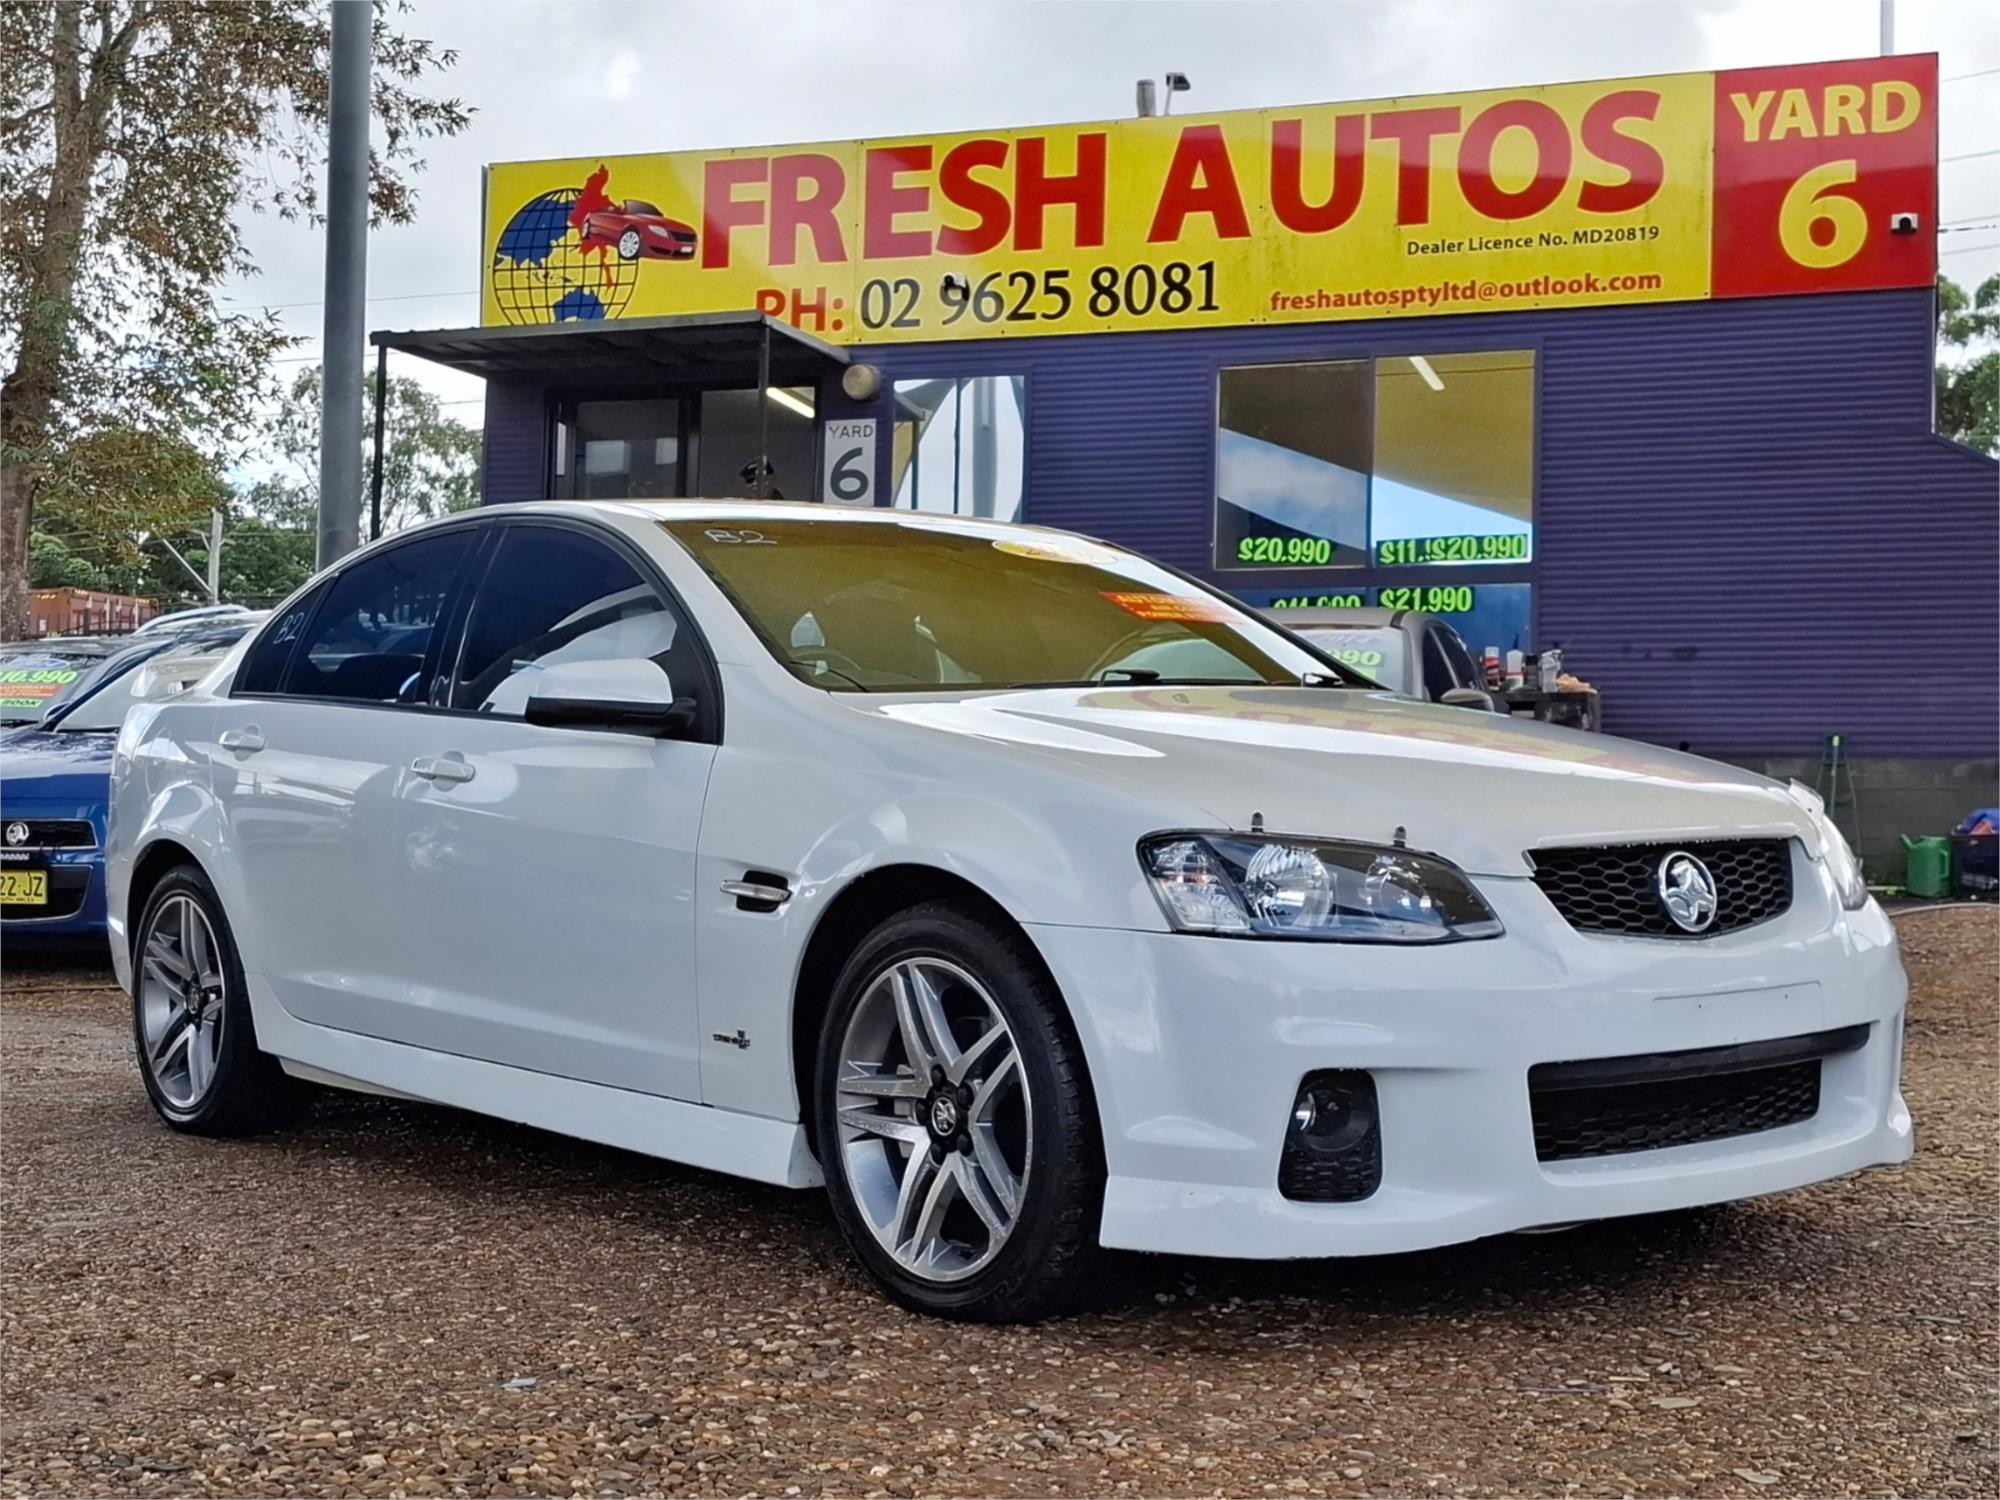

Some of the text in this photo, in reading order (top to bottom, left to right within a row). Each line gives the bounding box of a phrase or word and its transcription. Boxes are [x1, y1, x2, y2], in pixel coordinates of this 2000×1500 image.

[1729, 80, 1922, 142] YARD
[701, 90, 1664, 269] FRESH AUTOS
[1407, 225, 1660, 256] Dealer Licence No. MD20819
[1779, 159, 1868, 269] 6
[756, 259, 1221, 332] PH: 02 9625 8081
[1270, 271, 1663, 311] freshautosptyltd@outlook.com
[828, 424, 874, 439] YARD
[830, 446, 870, 501] 6
[703, 528, 779, 545] B2
